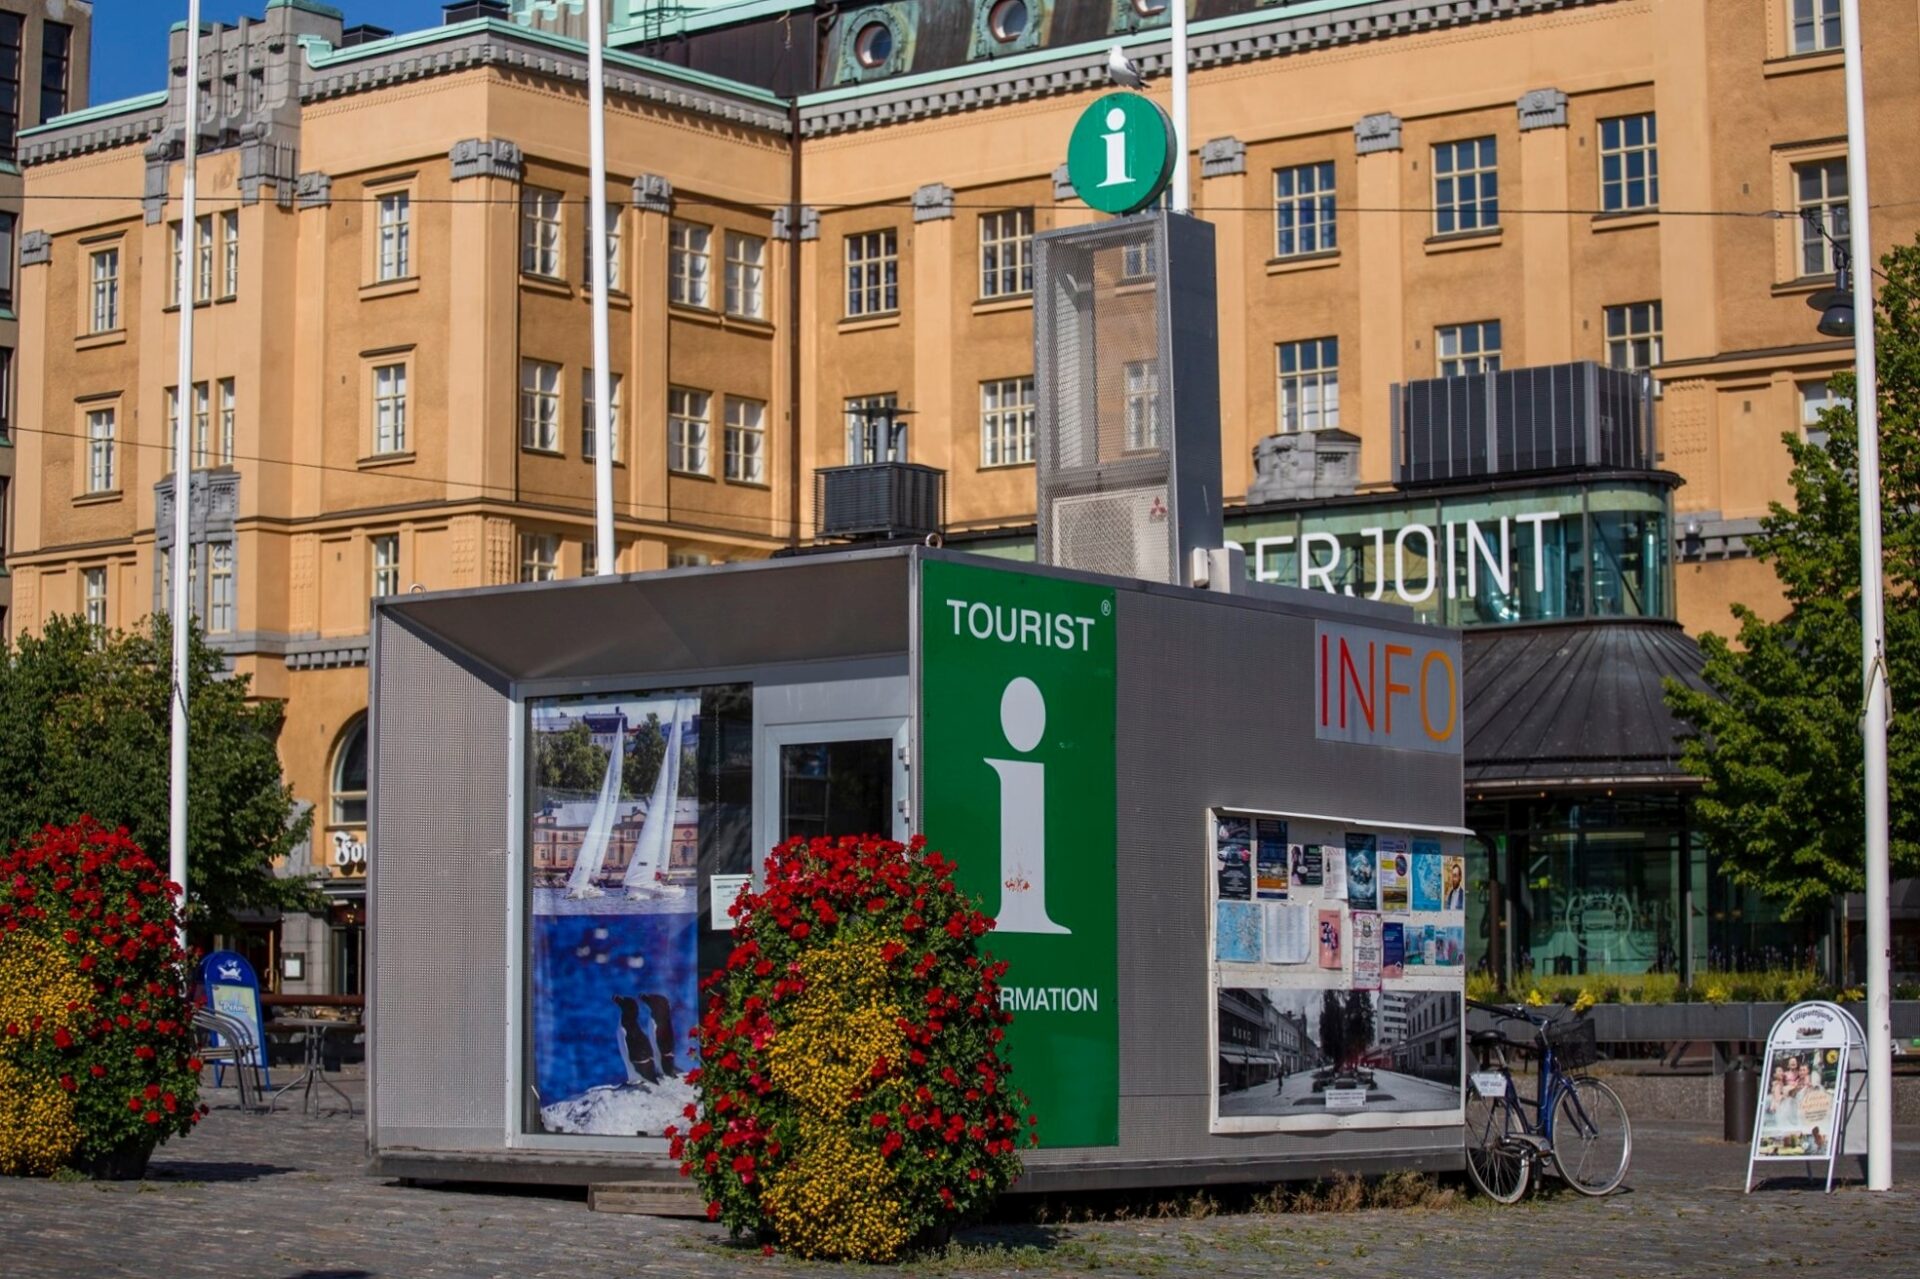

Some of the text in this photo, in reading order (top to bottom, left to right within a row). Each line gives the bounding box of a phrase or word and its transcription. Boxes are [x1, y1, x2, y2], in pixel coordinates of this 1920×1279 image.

[1223, 511, 1560, 603] ERJOINT
[946, 599, 1096, 651] TOURIST
[1321, 634, 1457, 742] INFO
[996, 986, 1098, 1012] RMATION
